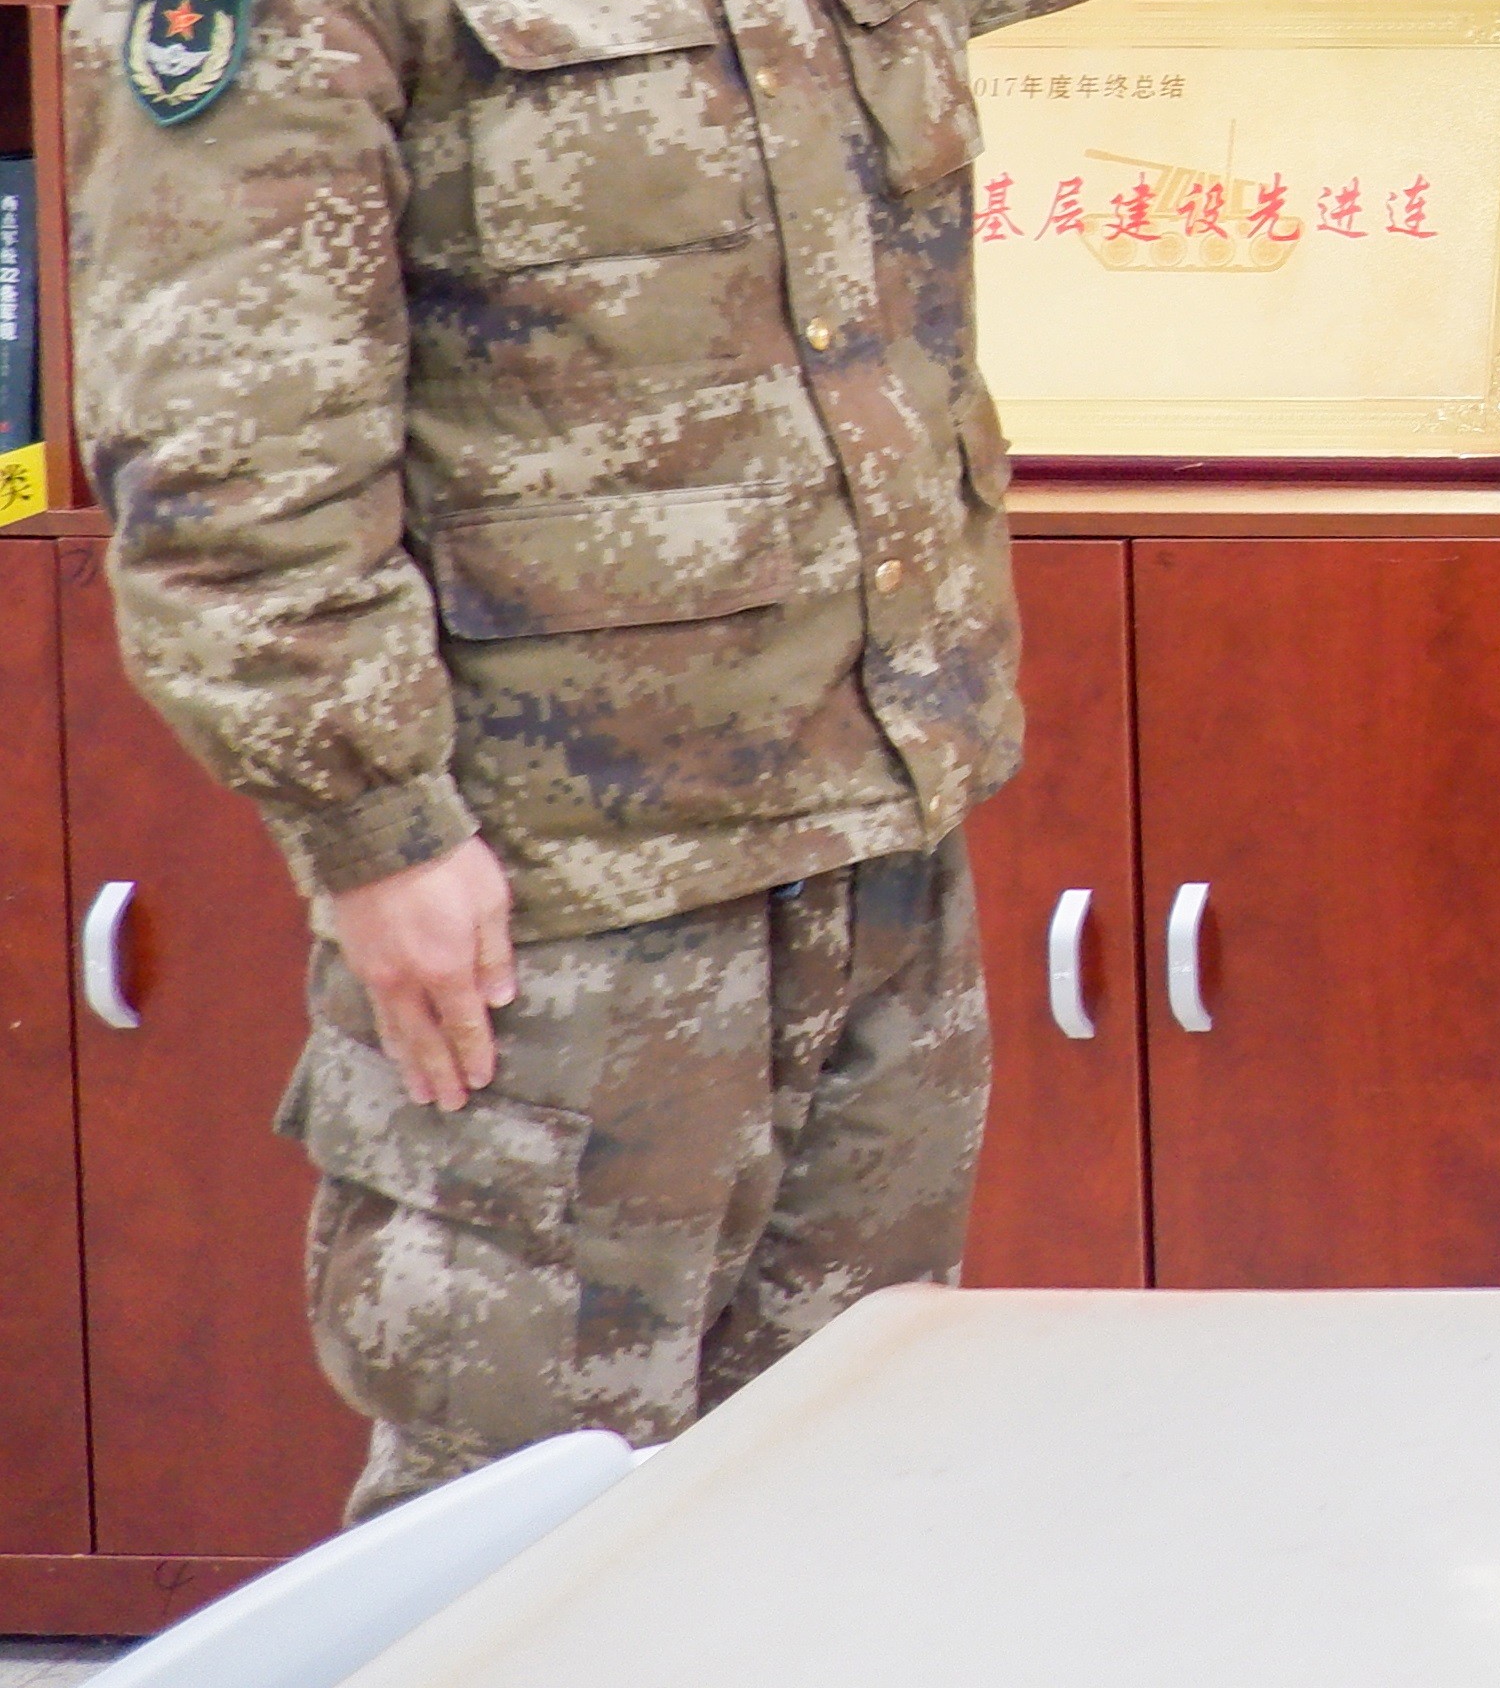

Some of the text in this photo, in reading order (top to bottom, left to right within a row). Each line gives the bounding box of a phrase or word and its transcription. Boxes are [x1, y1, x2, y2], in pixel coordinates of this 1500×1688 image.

[974, 73, 1187, 100] 017年度年终总结
[973, 172, 1438, 243] 基层建设先进连
